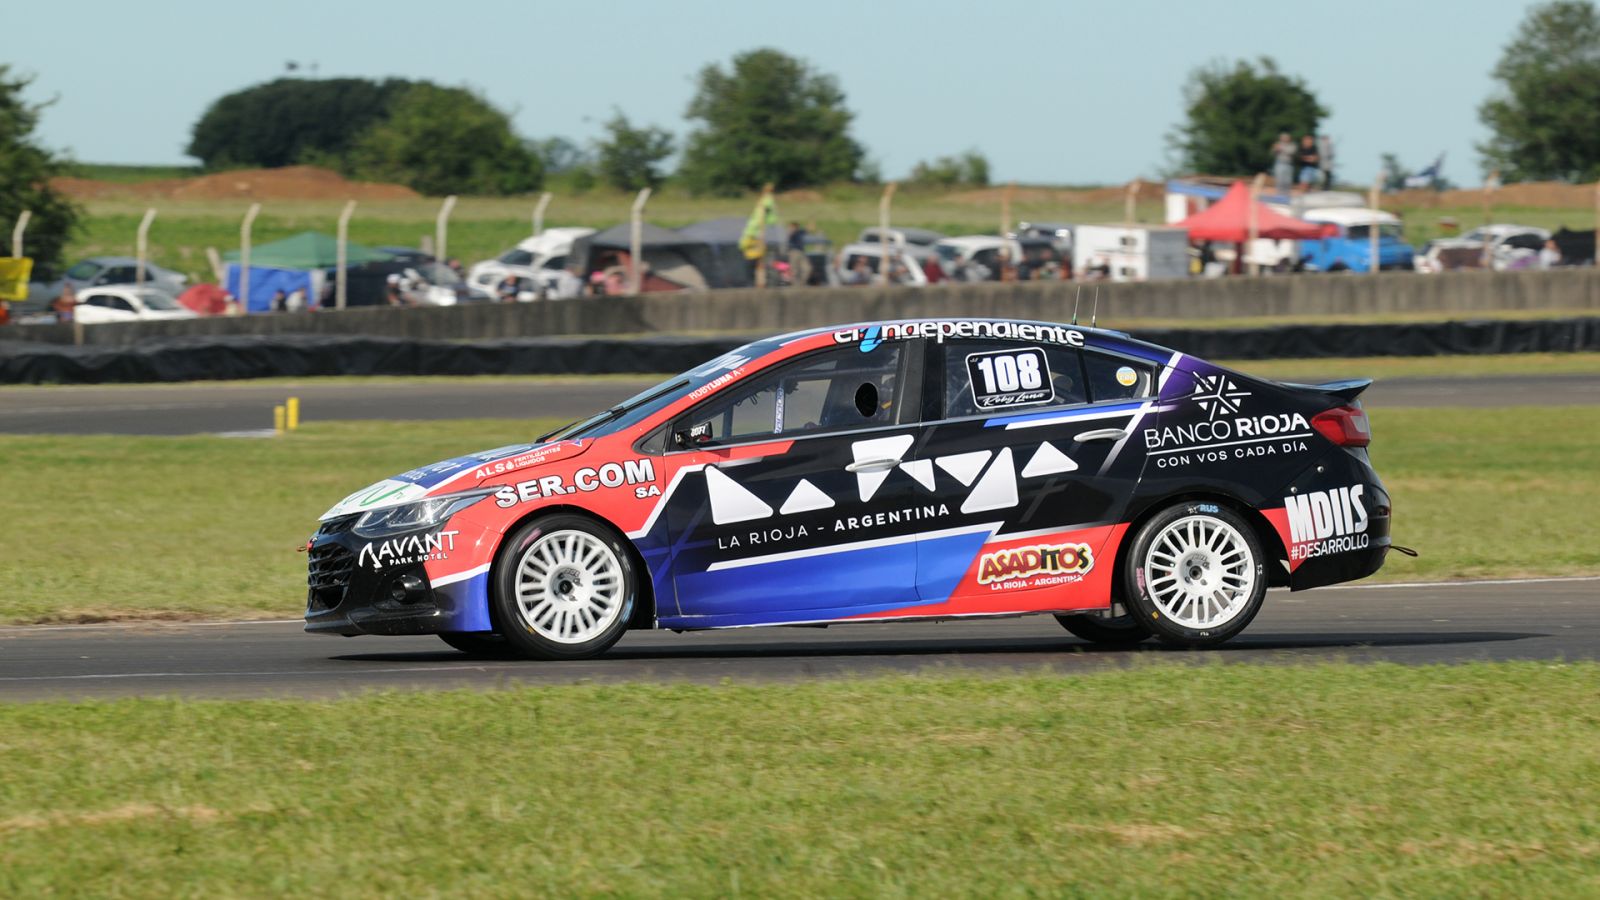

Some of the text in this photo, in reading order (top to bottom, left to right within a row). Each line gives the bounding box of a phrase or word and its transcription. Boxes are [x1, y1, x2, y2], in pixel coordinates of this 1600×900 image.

[978, 353, 1042, 394] 108
[983, 392, 1045, 407] Roby Luna
[1144, 420, 1231, 449] BANCO
[514, 446, 561, 463] FERTILIZANTES
[1157, 441, 1308, 468] CON VOS CADA DÍA
[475, 463, 506, 479] ALS
[495, 458, 656, 508] SER.COM
[635, 485, 662, 499] SA
[1199, 504, 1219, 513] RUS
[718, 536, 741, 550] LA
[750, 524, 808, 545] RIOJA
[834, 503, 950, 532] ARGENTINA
[1291, 533, 1369, 561] #DESARROLLO
[389, 552, 448, 566] PARK HOTEL
[980, 546, 1090, 581] ASADITOS
[991, 582, 1002, 590] LA
[1004, 580, 1027, 590] RIOJA
[1034, 575, 1083, 586] ARGENTINA
